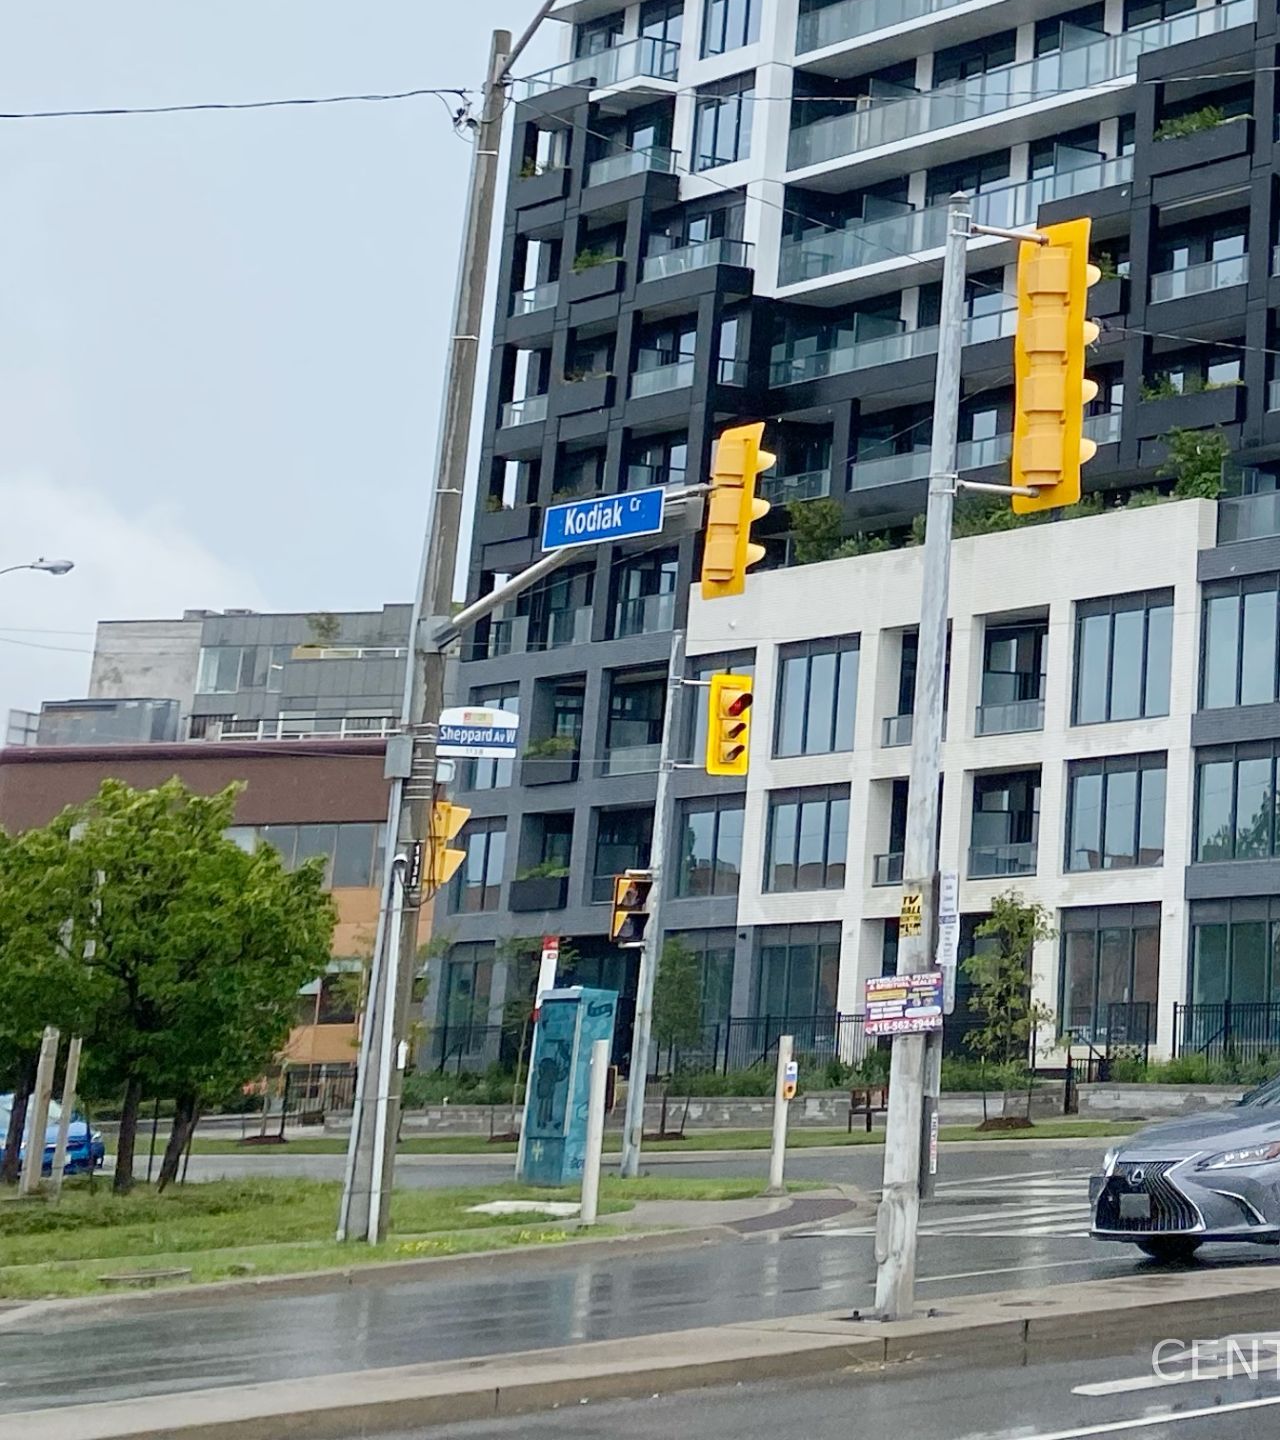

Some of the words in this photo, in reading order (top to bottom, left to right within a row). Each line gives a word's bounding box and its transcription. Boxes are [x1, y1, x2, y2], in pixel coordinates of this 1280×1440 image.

[564, 500, 623, 536] Kodiak
[630, 497, 641, 512] Cr
[440, 726, 493, 744] Sheppard
[494, 731, 505, 743] Av
[506, 729, 516, 743] W
